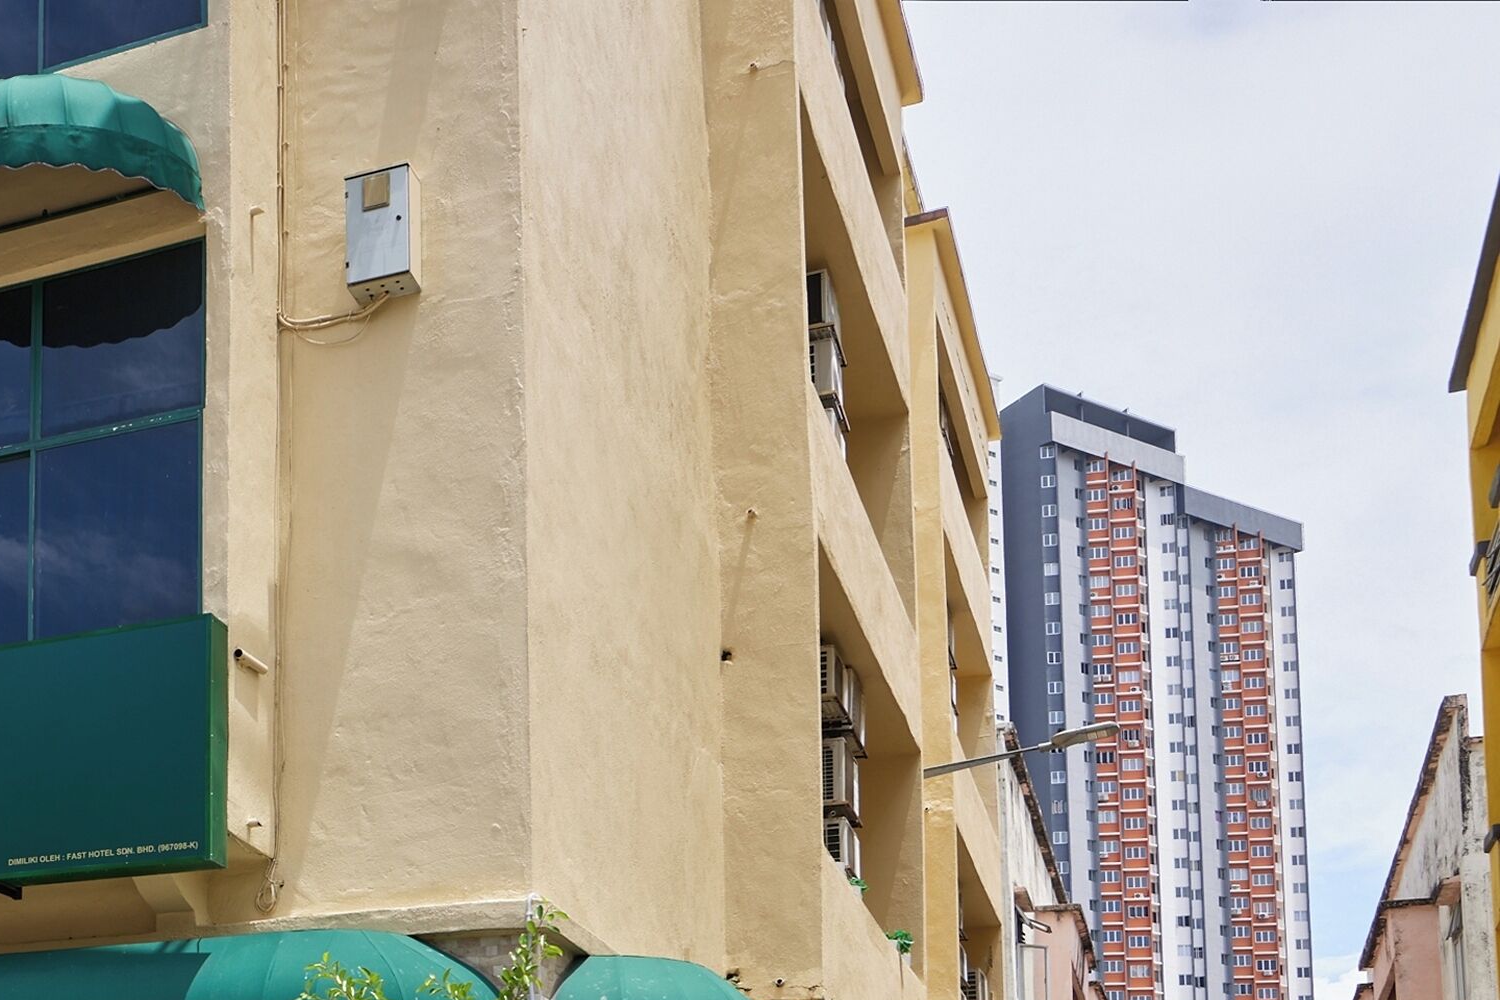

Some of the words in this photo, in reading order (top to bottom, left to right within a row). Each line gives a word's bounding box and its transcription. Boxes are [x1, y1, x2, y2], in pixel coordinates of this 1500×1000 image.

[8, 857, 38, 866] DIMILIKI
[39, 854, 61, 863] OLEH
[66, 852, 87, 860] FAST
[88, 849, 114, 858] HOTEL
[116, 847, 135, 856] SDN.
[136, 845, 156, 854] BHD.
